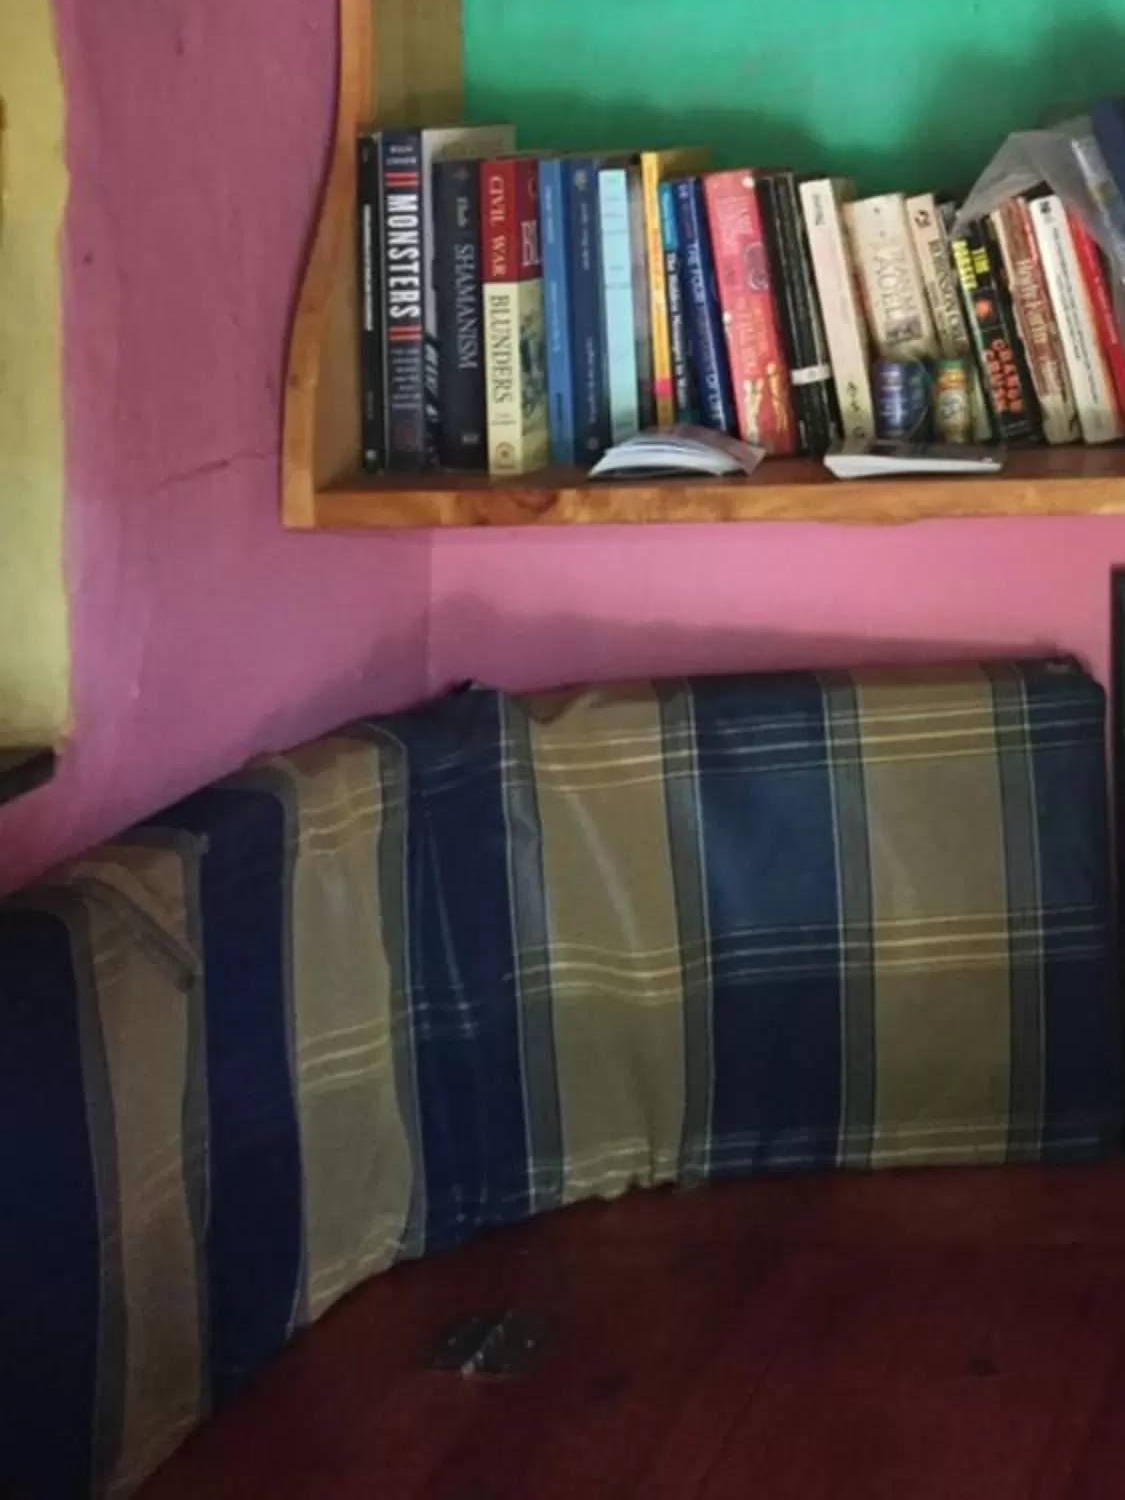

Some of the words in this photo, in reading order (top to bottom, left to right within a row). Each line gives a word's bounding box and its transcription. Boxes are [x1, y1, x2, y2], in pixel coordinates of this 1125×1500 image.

[386, 193, 420, 318] MONSTERS
[487, 175, 505, 226] CIVIL
[489, 235, 507, 276] WAR
[452, 243, 478, 369] SHAMANISM
[488, 294, 513, 404] BLUNDERS
